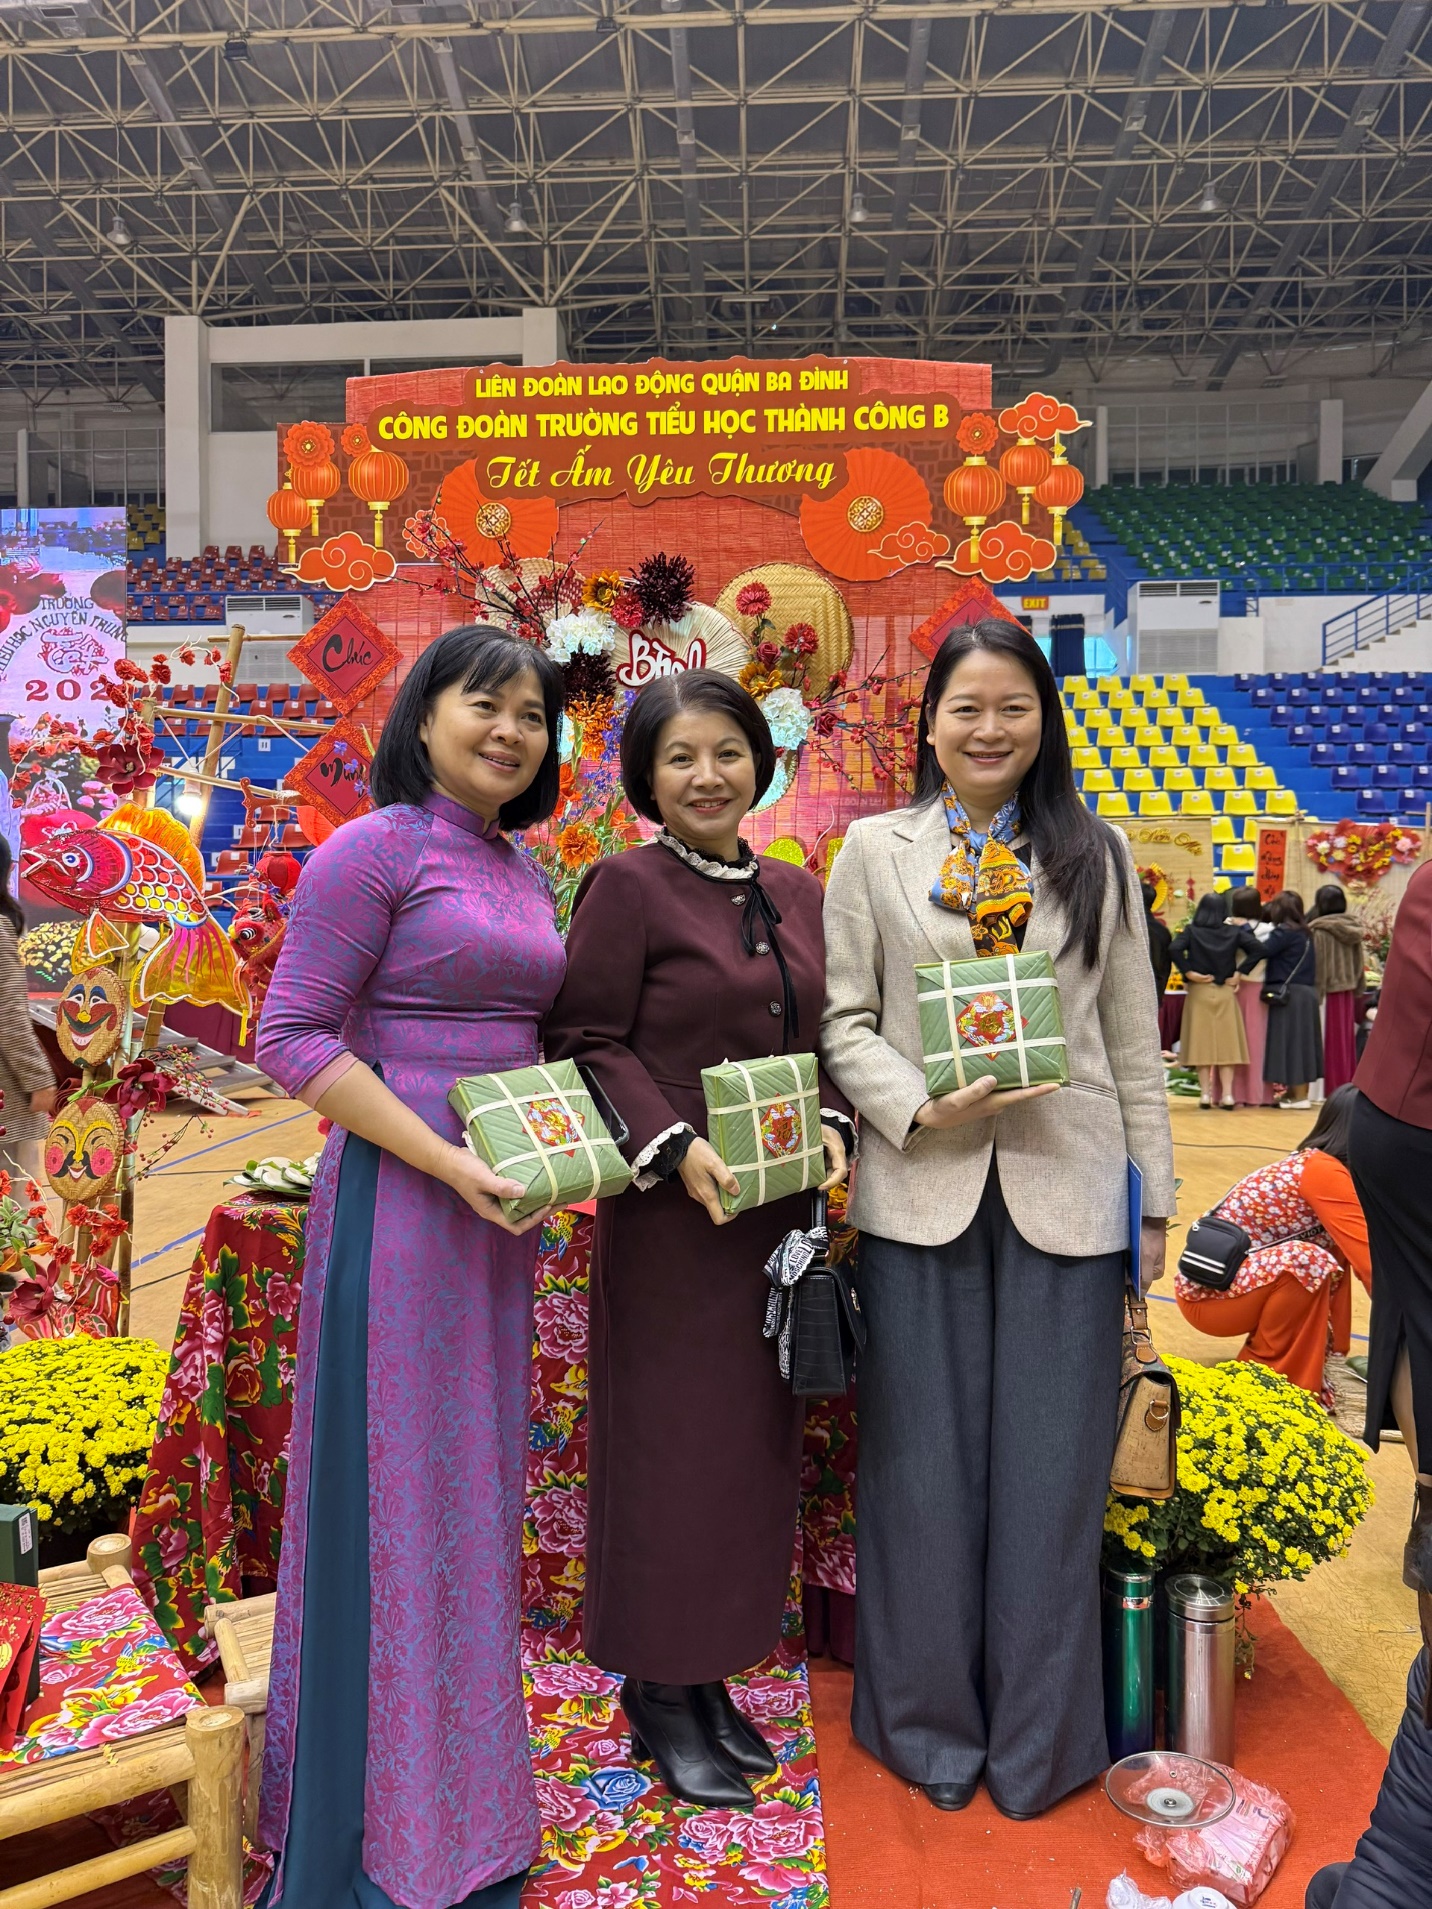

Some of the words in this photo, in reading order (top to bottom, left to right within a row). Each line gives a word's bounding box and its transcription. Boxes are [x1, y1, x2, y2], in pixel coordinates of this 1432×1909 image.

[475, 374, 516, 398] LIÊN
[523, 373, 582, 397] ĐOÀN
[588, 375, 628, 396] LAO
[635, 370, 695, 399] ĐỘNG
[701, 368, 760, 397] QUẬN
[766, 371, 792, 392] BA
[799, 366, 848, 391] ĐÌNH
[378, 411, 448, 440] CÔNG
[456, 409, 528, 439] ĐOÀN
[535, 407, 638, 437] TRƯỜNG
[646, 401, 696, 436] TIỂU
[703, 409, 756, 440] HỌC
[763, 403, 846, 433] THÀNH
[853, 400, 926, 431] CÔNG
[933, 404, 950, 429] B
[486, 455, 542, 489] Tết
[550, 444, 615, 487] Ấm
[626, 454, 696, 494] Yêu
[708, 452, 837, 490] Thương
[1023, 598, 1047, 609] EXIT
[322, 634, 373, 672] Chúc
